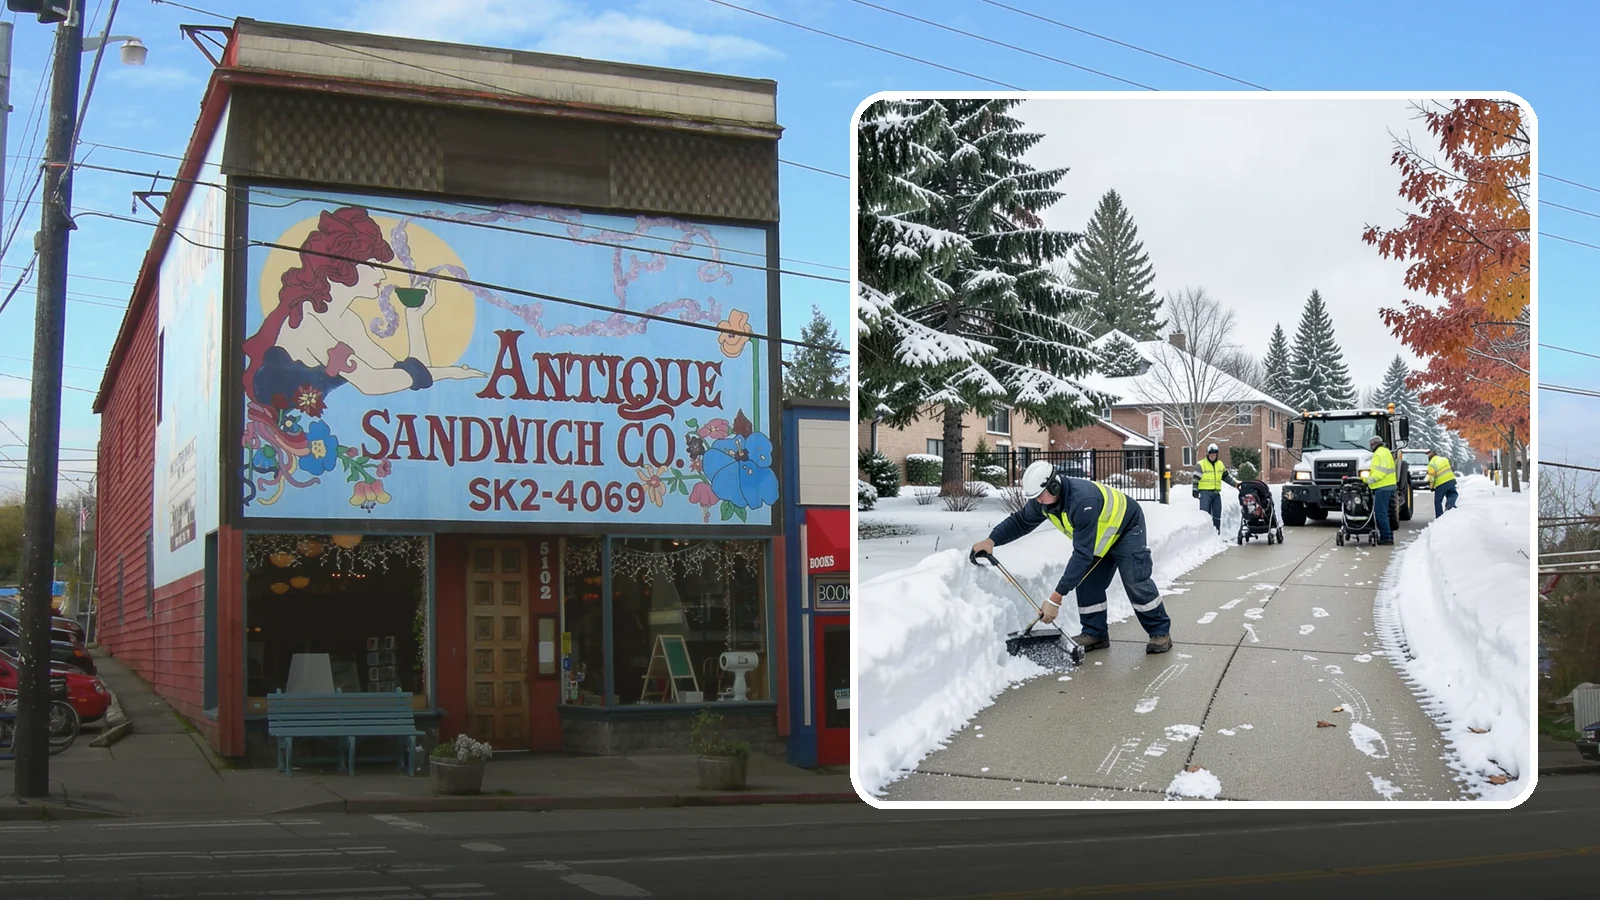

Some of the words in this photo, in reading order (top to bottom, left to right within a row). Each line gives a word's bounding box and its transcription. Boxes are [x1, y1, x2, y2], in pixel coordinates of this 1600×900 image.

[475, 329, 724, 421] ANTIQUE
[361, 408, 604, 467] SANDWICH
[617, 422, 685, 468] CO.
[468, 477, 645, 513] SK2-4069
[539, 542, 552, 600] 5102
[809, 555, 835, 569] BOOKS
